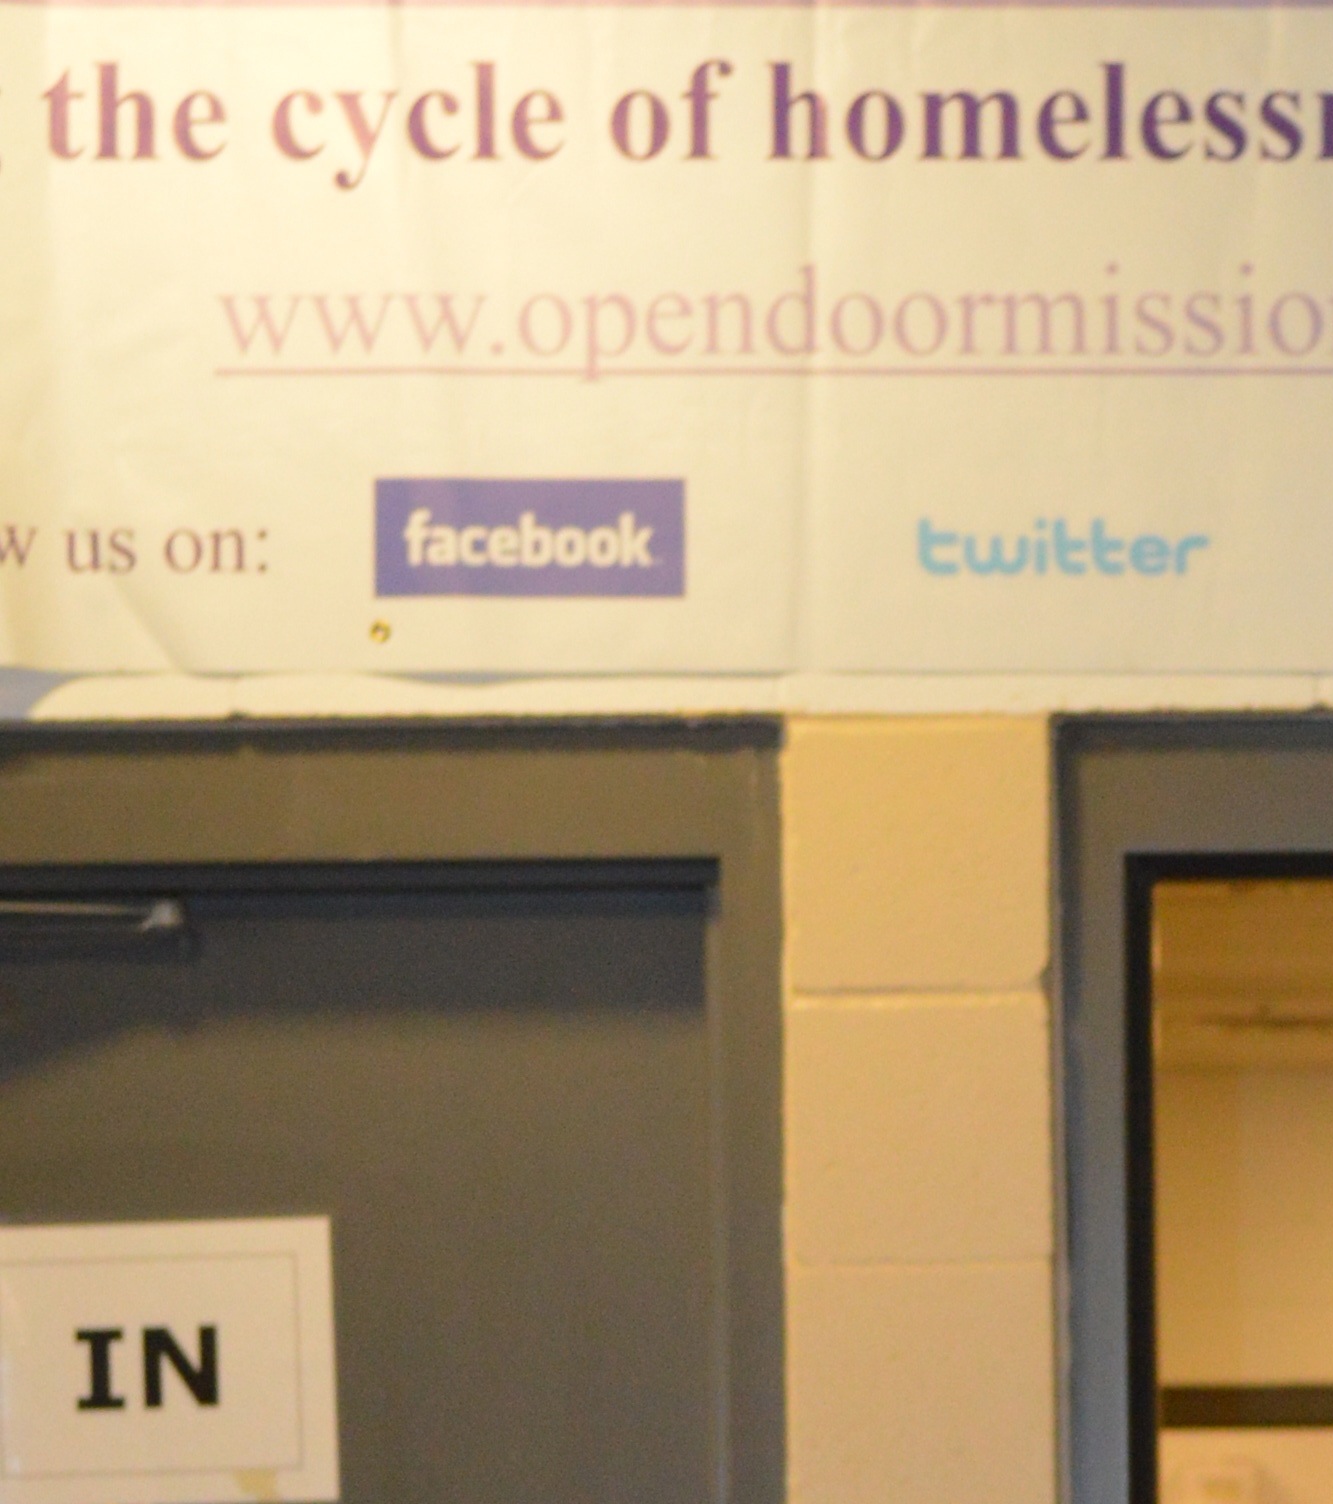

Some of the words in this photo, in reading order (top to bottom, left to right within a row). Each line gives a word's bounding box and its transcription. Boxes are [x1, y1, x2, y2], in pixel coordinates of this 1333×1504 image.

[42, 61, 230, 164] the
[269, 61, 566, 191] cycle
[609, 60, 735, 164] of
[64, 526, 137, 574] us
[163, 526, 271, 573] on:
[404, 508, 656, 569] facebook
[917, 515, 1211, 579] twitter
[75, 1322, 219, 1411] IN
